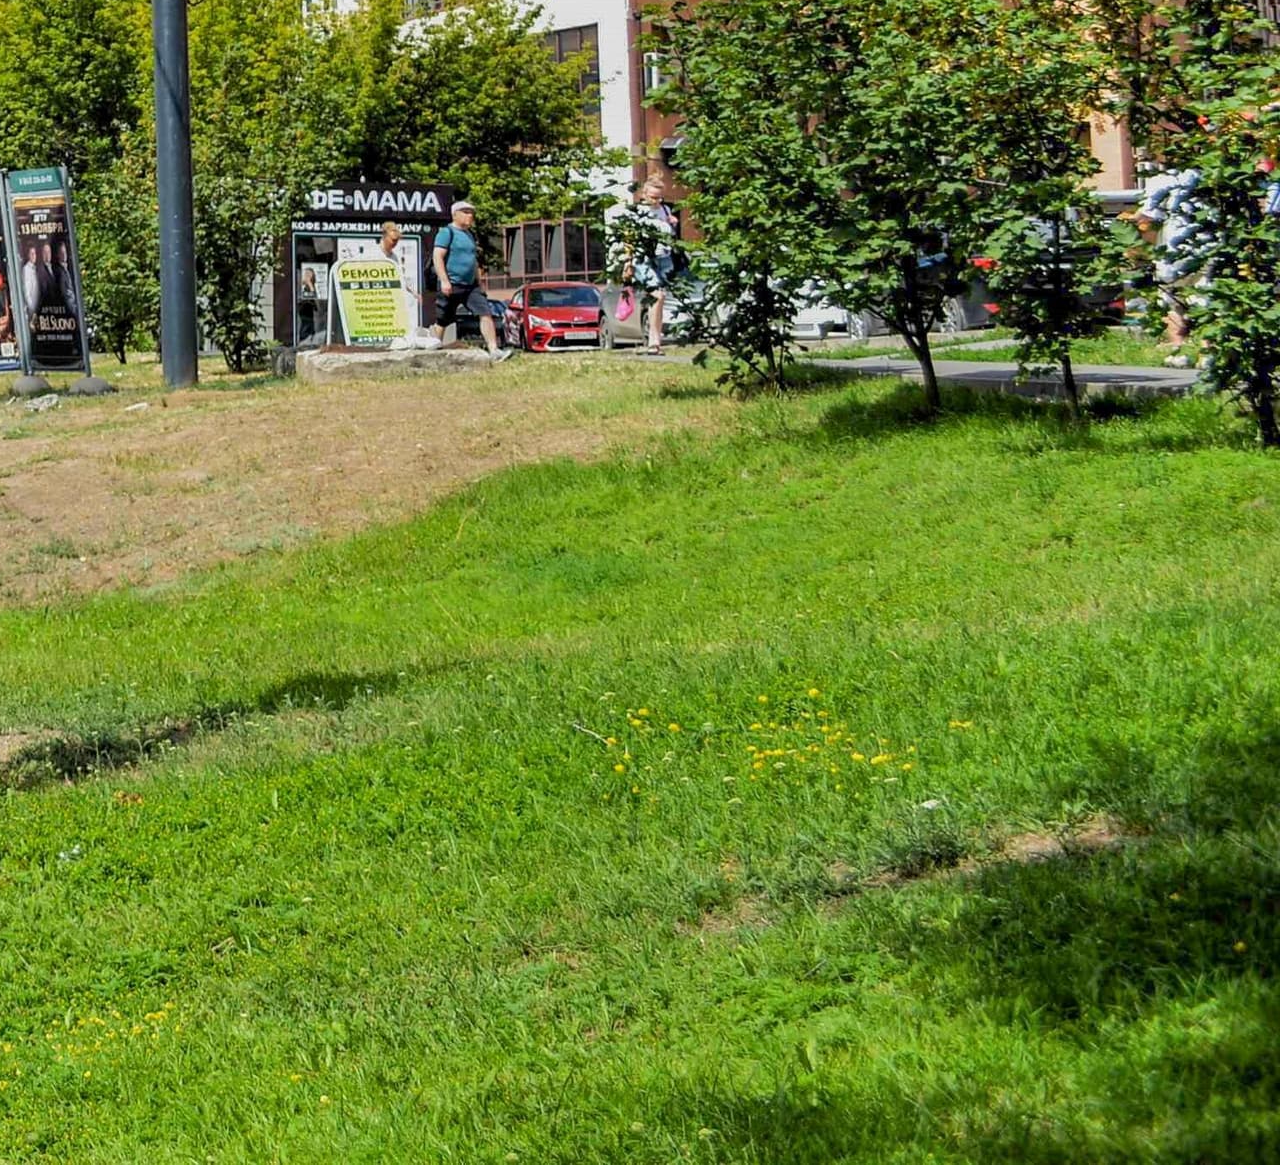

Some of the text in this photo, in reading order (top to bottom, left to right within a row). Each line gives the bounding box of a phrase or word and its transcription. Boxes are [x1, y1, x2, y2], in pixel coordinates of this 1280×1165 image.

[353, 189, 442, 213] МАМА
[20, 221, 64, 235] 13 НОЯБРЯ
[291, 221, 321, 231] КОФЕ
[322, 221, 371, 232] ЗАРЯЖЕН
[341, 268, 396, 279] РЕМОНТ
